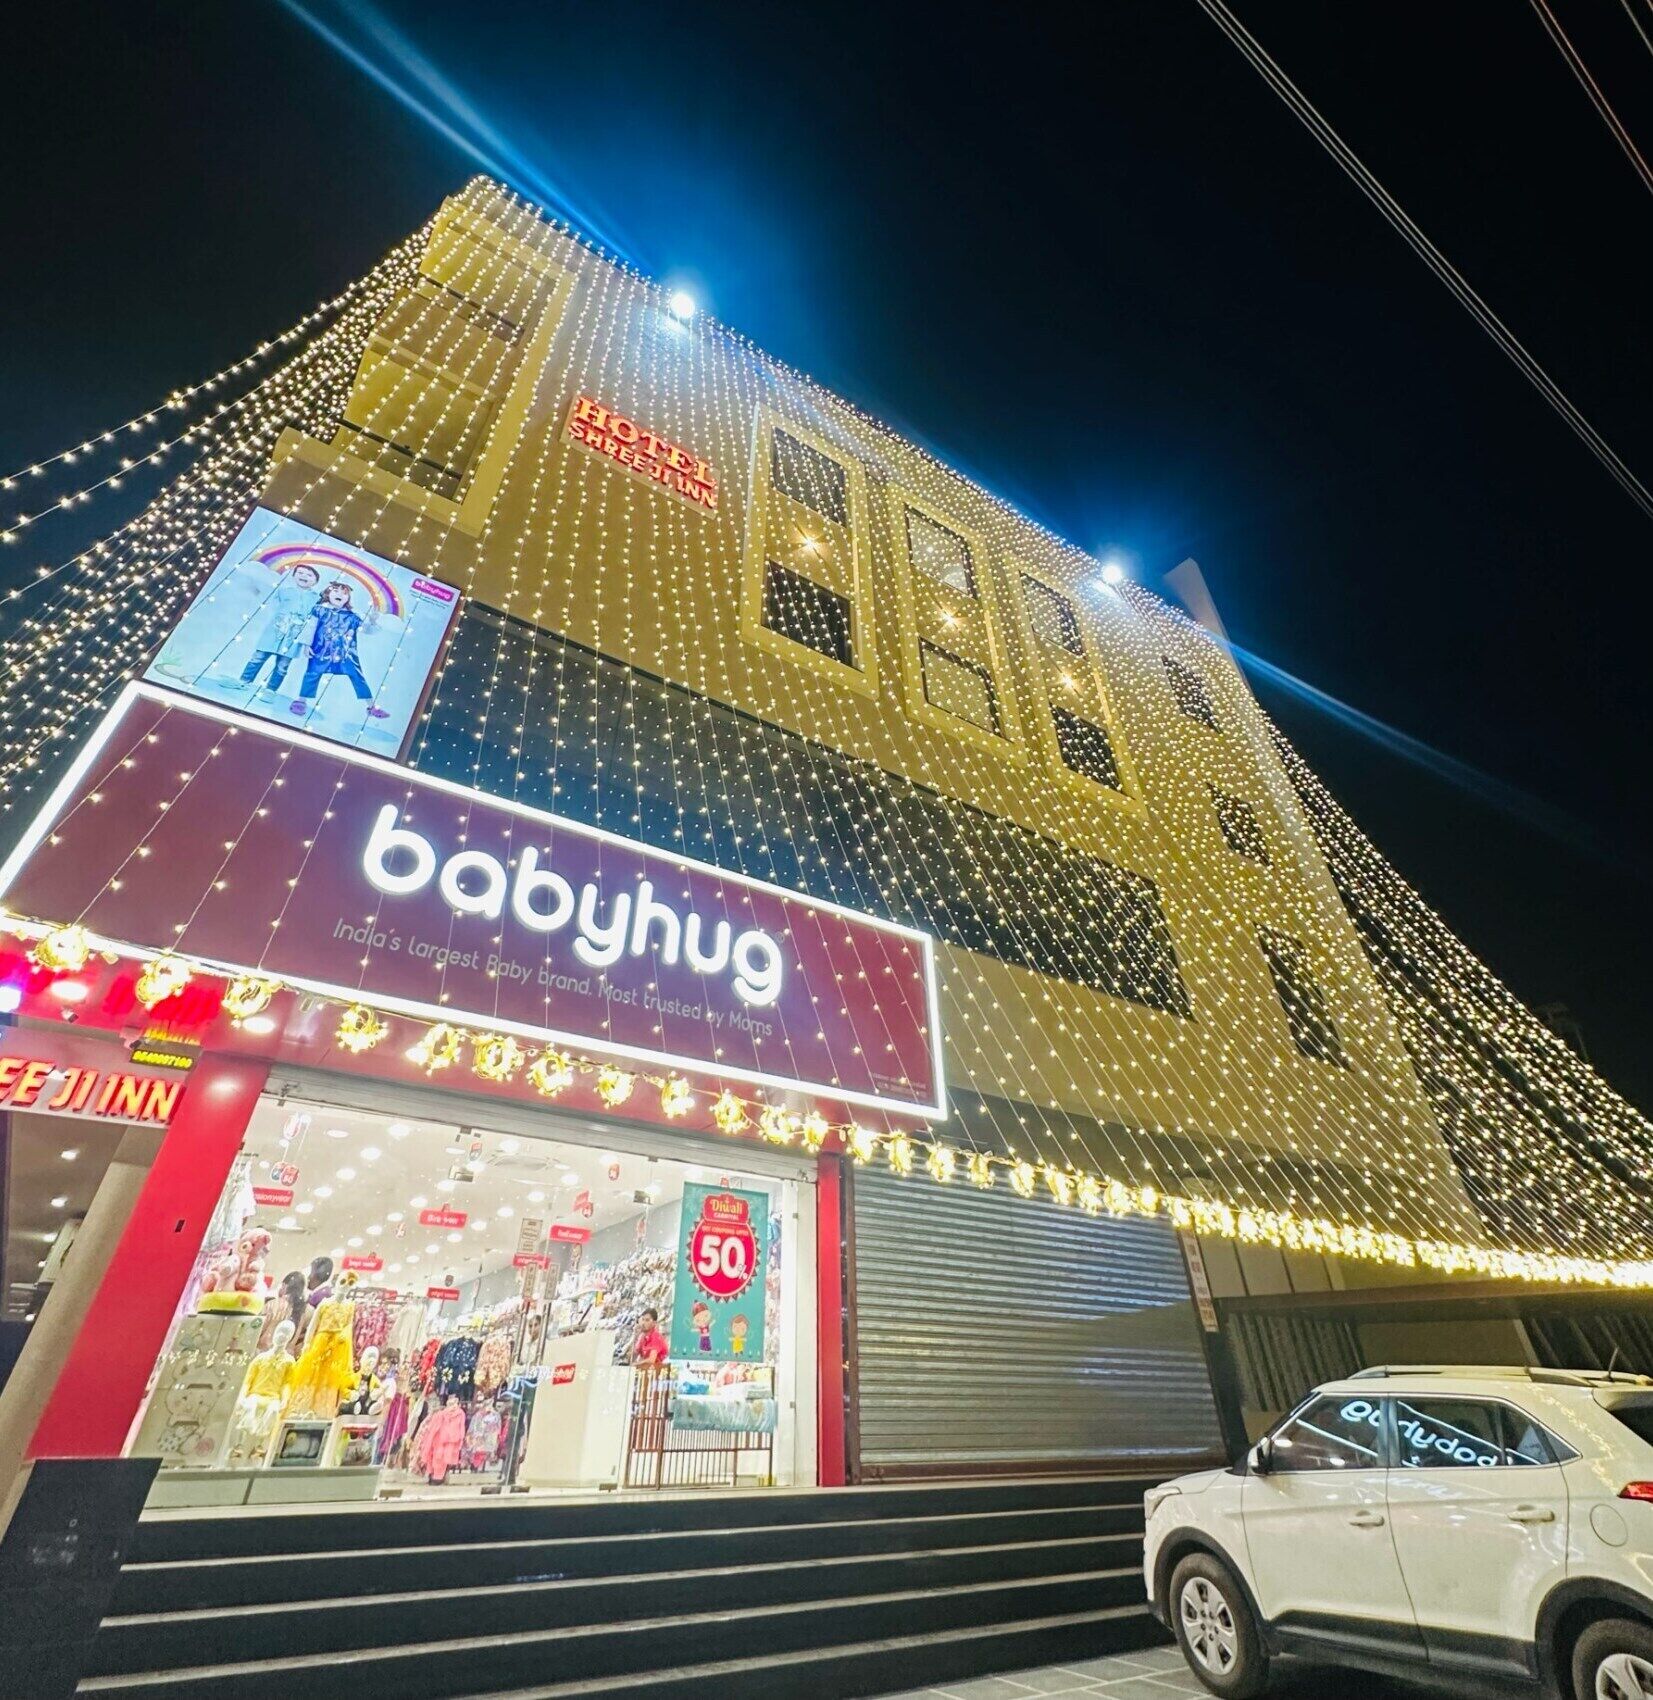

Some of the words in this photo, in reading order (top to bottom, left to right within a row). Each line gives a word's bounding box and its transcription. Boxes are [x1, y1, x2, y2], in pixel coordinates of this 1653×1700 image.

[568, 421, 647, 473] SHREE
[676, 477, 718, 508] INN
[574, 397, 717, 489] HOTEL
[362, 802, 784, 1007] babyhug
[333, 918, 402, 951] India's
[408, 936, 480, 970] largest
[485, 954, 533, 985] Baby
[598, 980, 639, 1006] Most
[643, 994, 702, 1020] trusted
[729, 1010, 774, 1036] Moms
[96, 1073, 183, 1122] INN
[709, 1198, 743, 1215] Diwali
